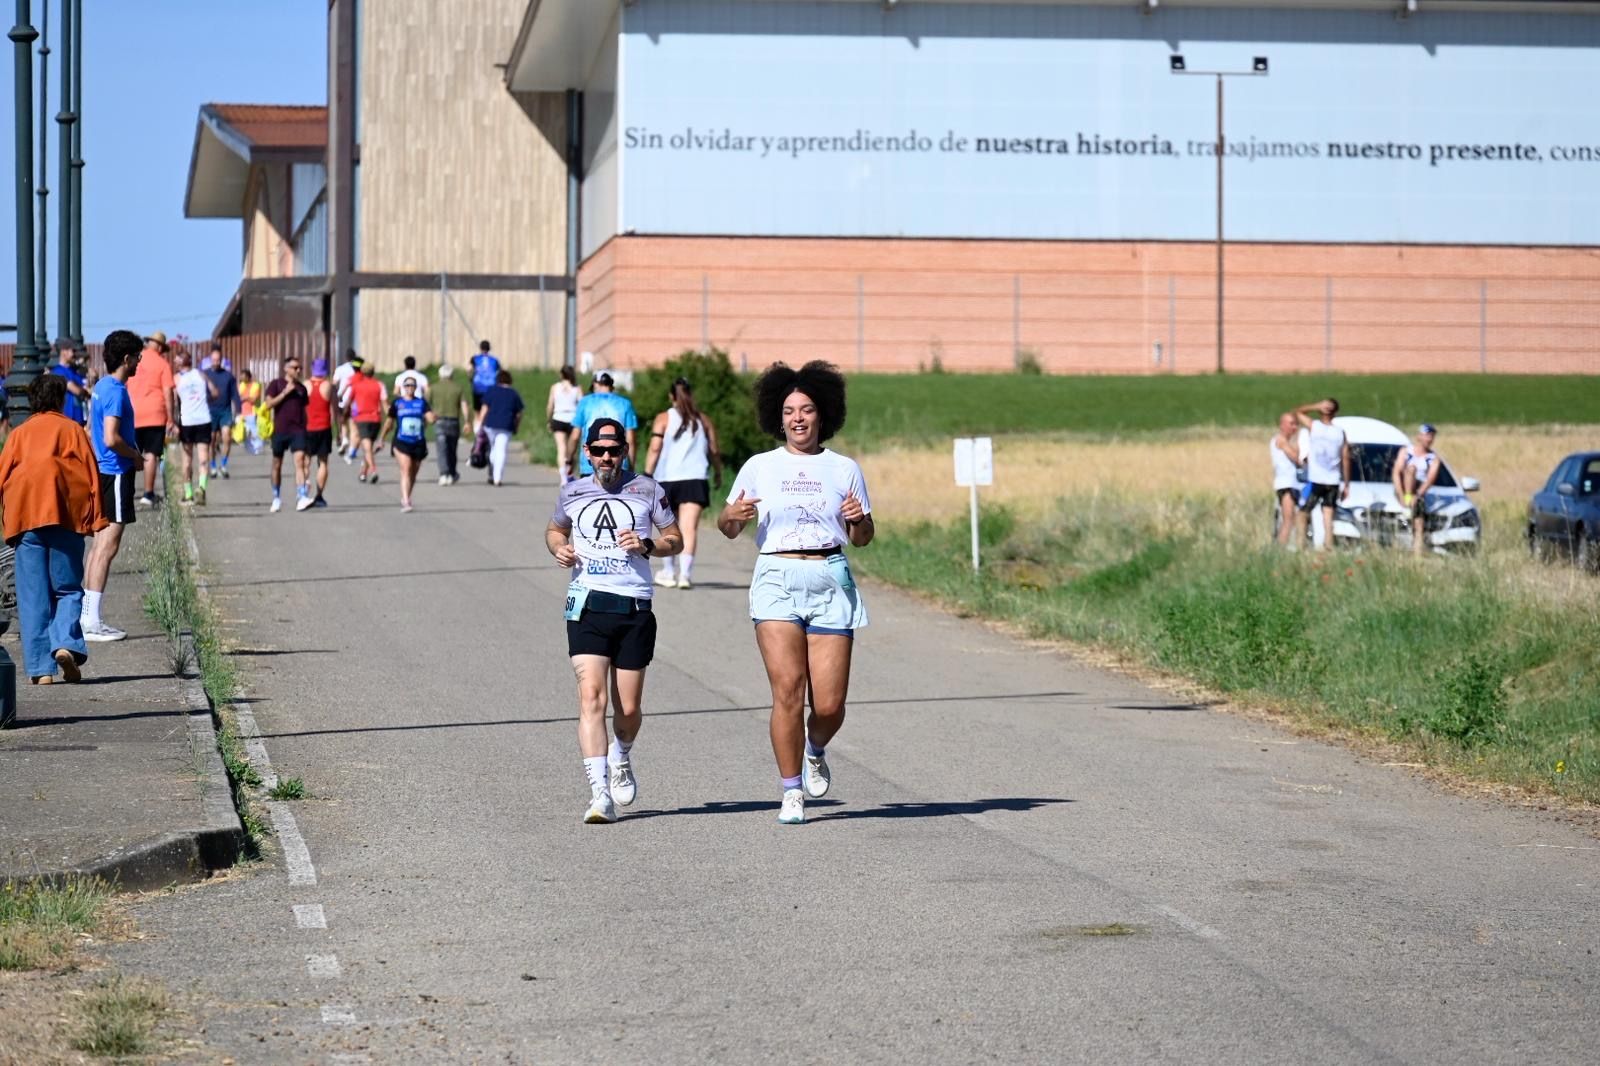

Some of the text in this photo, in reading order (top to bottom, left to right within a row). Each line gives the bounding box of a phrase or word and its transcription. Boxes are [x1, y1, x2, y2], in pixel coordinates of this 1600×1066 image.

[625, 126, 663, 150] Sin
[669, 127, 757, 152] olvidar
[760, 135, 775, 158] y
[776, 128, 933, 159] aprendiendo
[938, 130, 968, 153] de
[974, 136, 1070, 155] nuestra
[1075, 132, 1180, 160] historia,
[1327, 139, 1422, 161] nuestro
